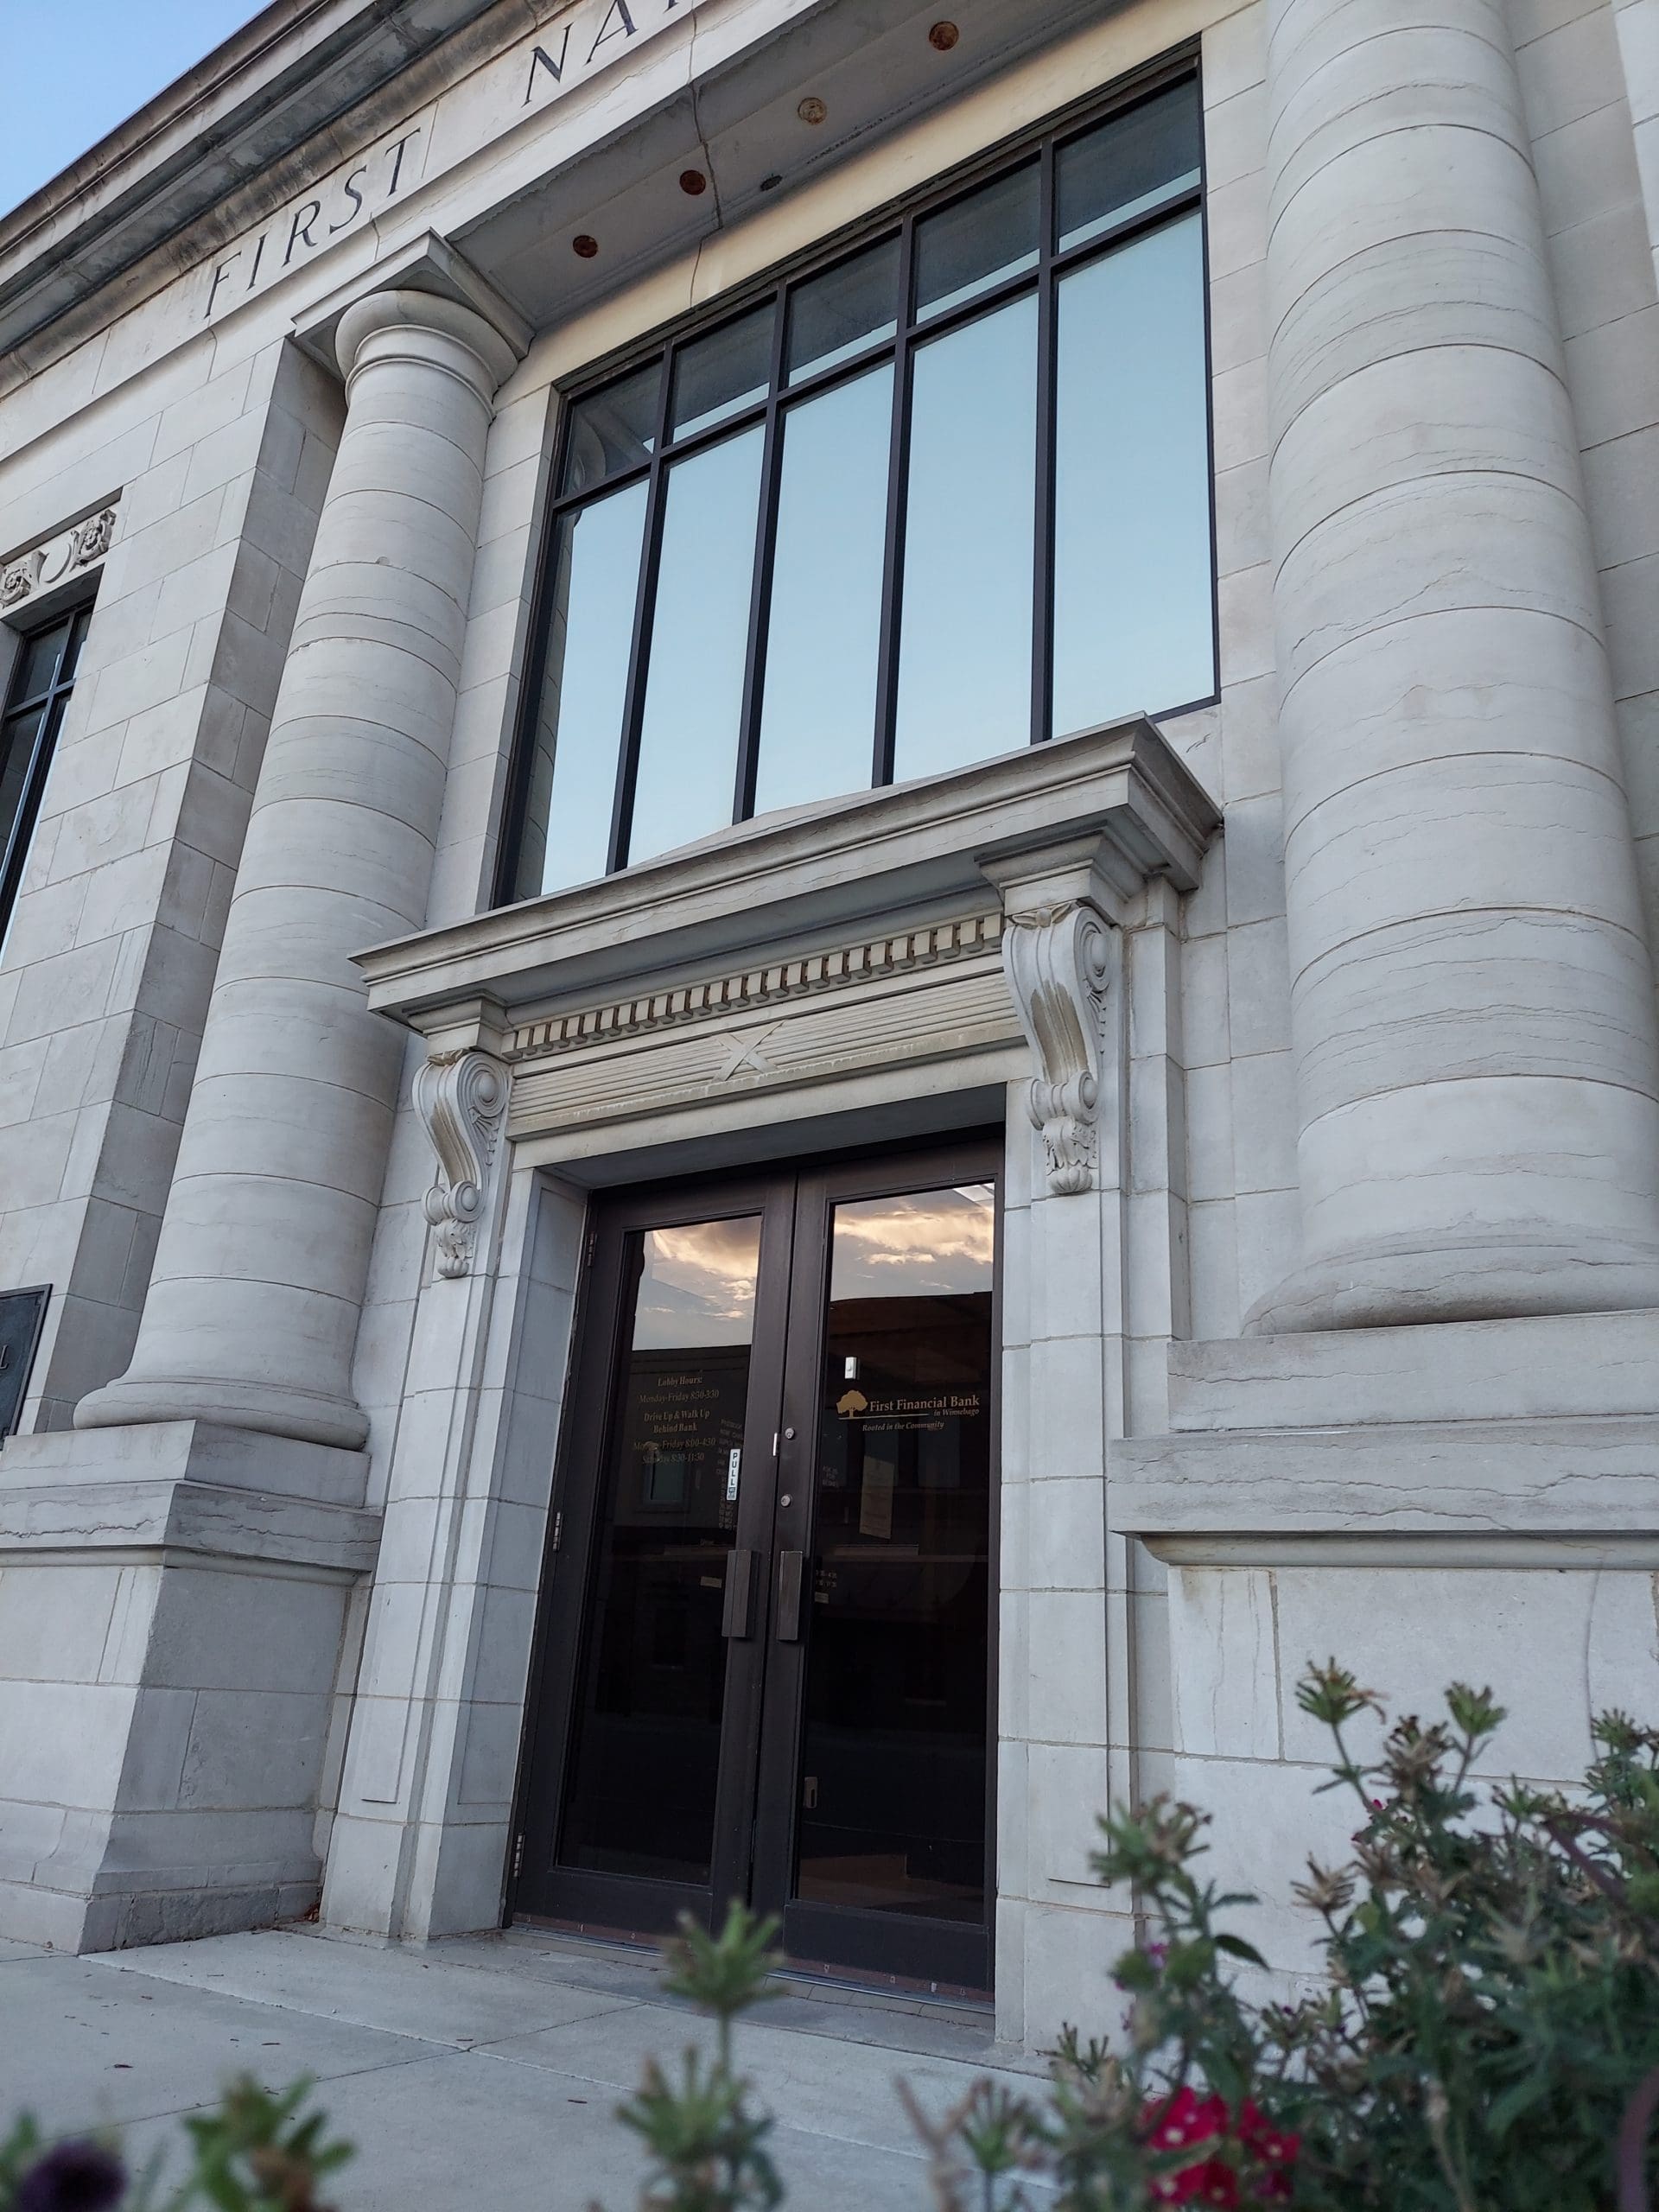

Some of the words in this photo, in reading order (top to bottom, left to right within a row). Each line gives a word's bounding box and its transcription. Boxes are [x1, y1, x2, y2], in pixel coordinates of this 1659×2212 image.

[203, 126, 421, 319] FIRST
[521, 0, 678, 107] NA
[658, 1376, 679, 1387] Lobby
[679, 1376, 702, 1385] Hours:
[638, 1391, 689, 1404] Monday-Friday
[869, 1400, 893, 1412] First
[897, 1396, 947, 1410] Financial
[950, 1395, 980, 1407] Bank
[644, 1411, 662, 1422] Drive
[664, 1411, 673, 1422] Up
[674, 1411, 680, 1420] &
[681, 1409, 698, 1419] Walk
[700, 1408, 710, 1420] Up
[943, 1408, 980, 1417] Winnebago
[653, 1423, 678, 1433] Behind
[679, 1422, 698, 1432] Bank
[862, 1423, 885, 1432] Rooted
[906, 1420, 944, 1431] Community
